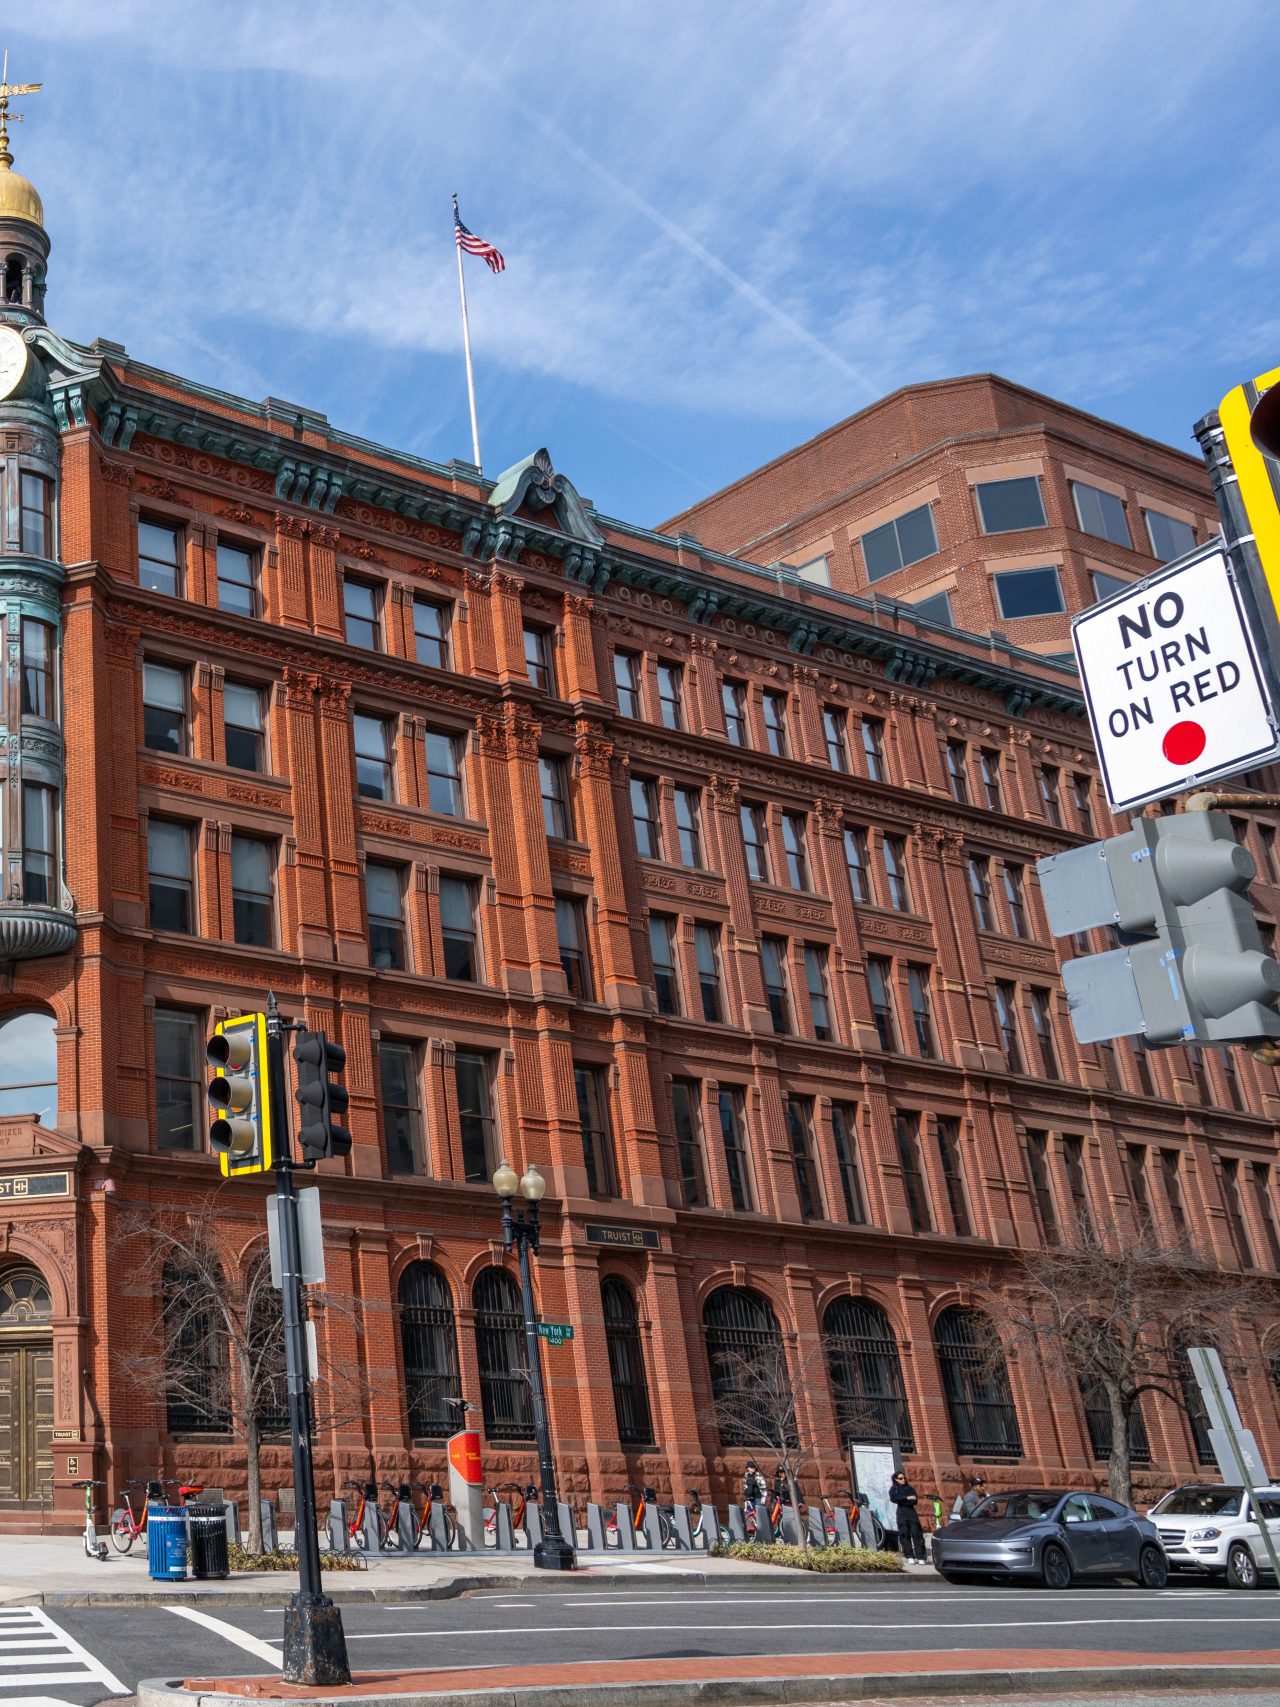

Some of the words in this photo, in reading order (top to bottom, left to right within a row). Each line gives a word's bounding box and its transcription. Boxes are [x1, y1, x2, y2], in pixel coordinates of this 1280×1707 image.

[1117, 591, 1185, 650] NO
[1116, 626, 1211, 691] TURN
[1108, 696, 1154, 738] ON
[1169, 660, 1241, 714] RED
[601, 1230, 632, 1242] TRUIST
[538, 1325, 549, 1334] New
[550, 1325, 563, 1336] York
